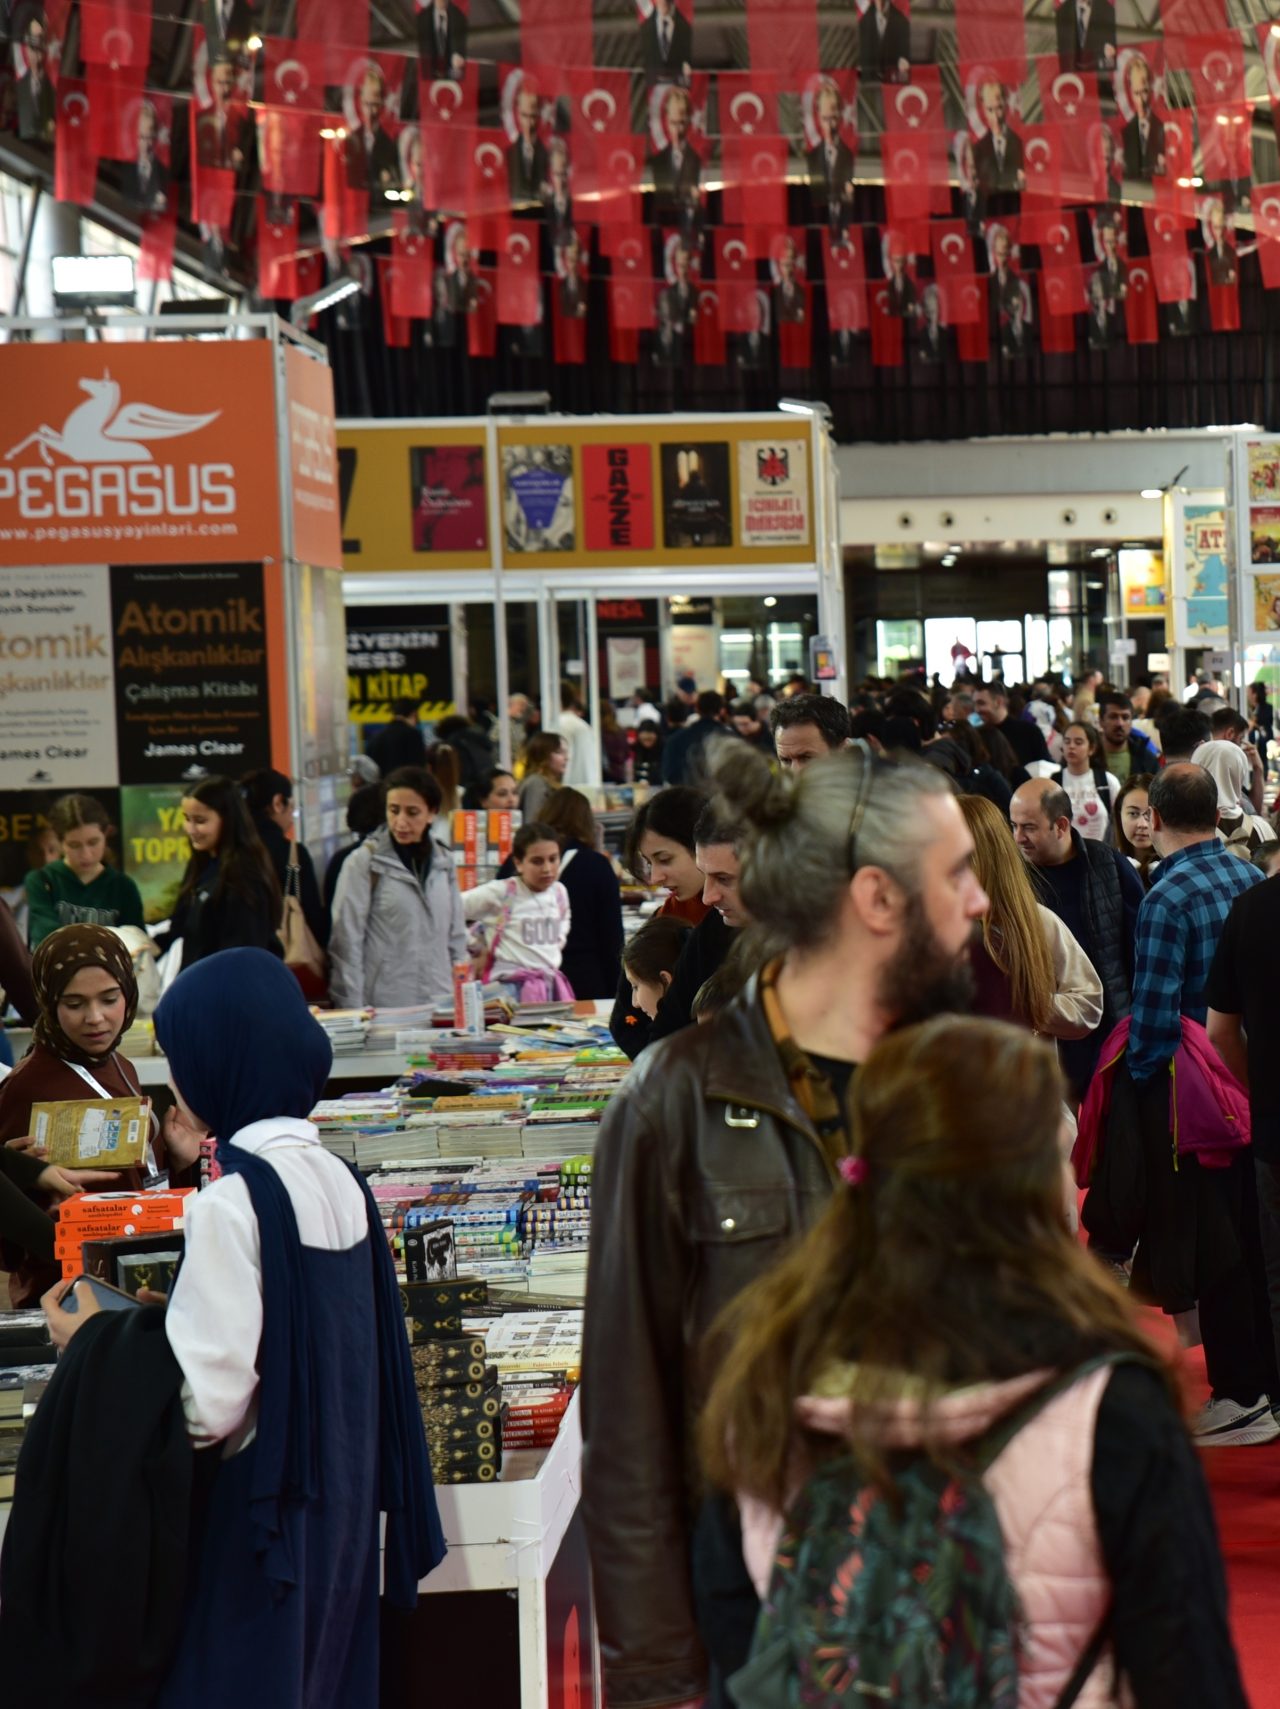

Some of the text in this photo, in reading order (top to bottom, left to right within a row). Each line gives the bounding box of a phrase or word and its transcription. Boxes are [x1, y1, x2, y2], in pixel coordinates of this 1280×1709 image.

[607, 448, 631, 547] GAZZE
[1199, 528, 1228, 549] AT
[117, 598, 262, 637] Atomik
[119, 643, 263, 674] Alışkanlıklar
[125, 680, 259, 703] Çalışma Kitabı
[366, 669, 428, 699] KİTAP
[45, 744, 88, 760] Clear
[144, 740, 245, 757] James Clear
[521, 917, 561, 946] GOO
[82, 1203, 128, 1213] safsatalar
[77, 1223, 121, 1233] safsatalar
